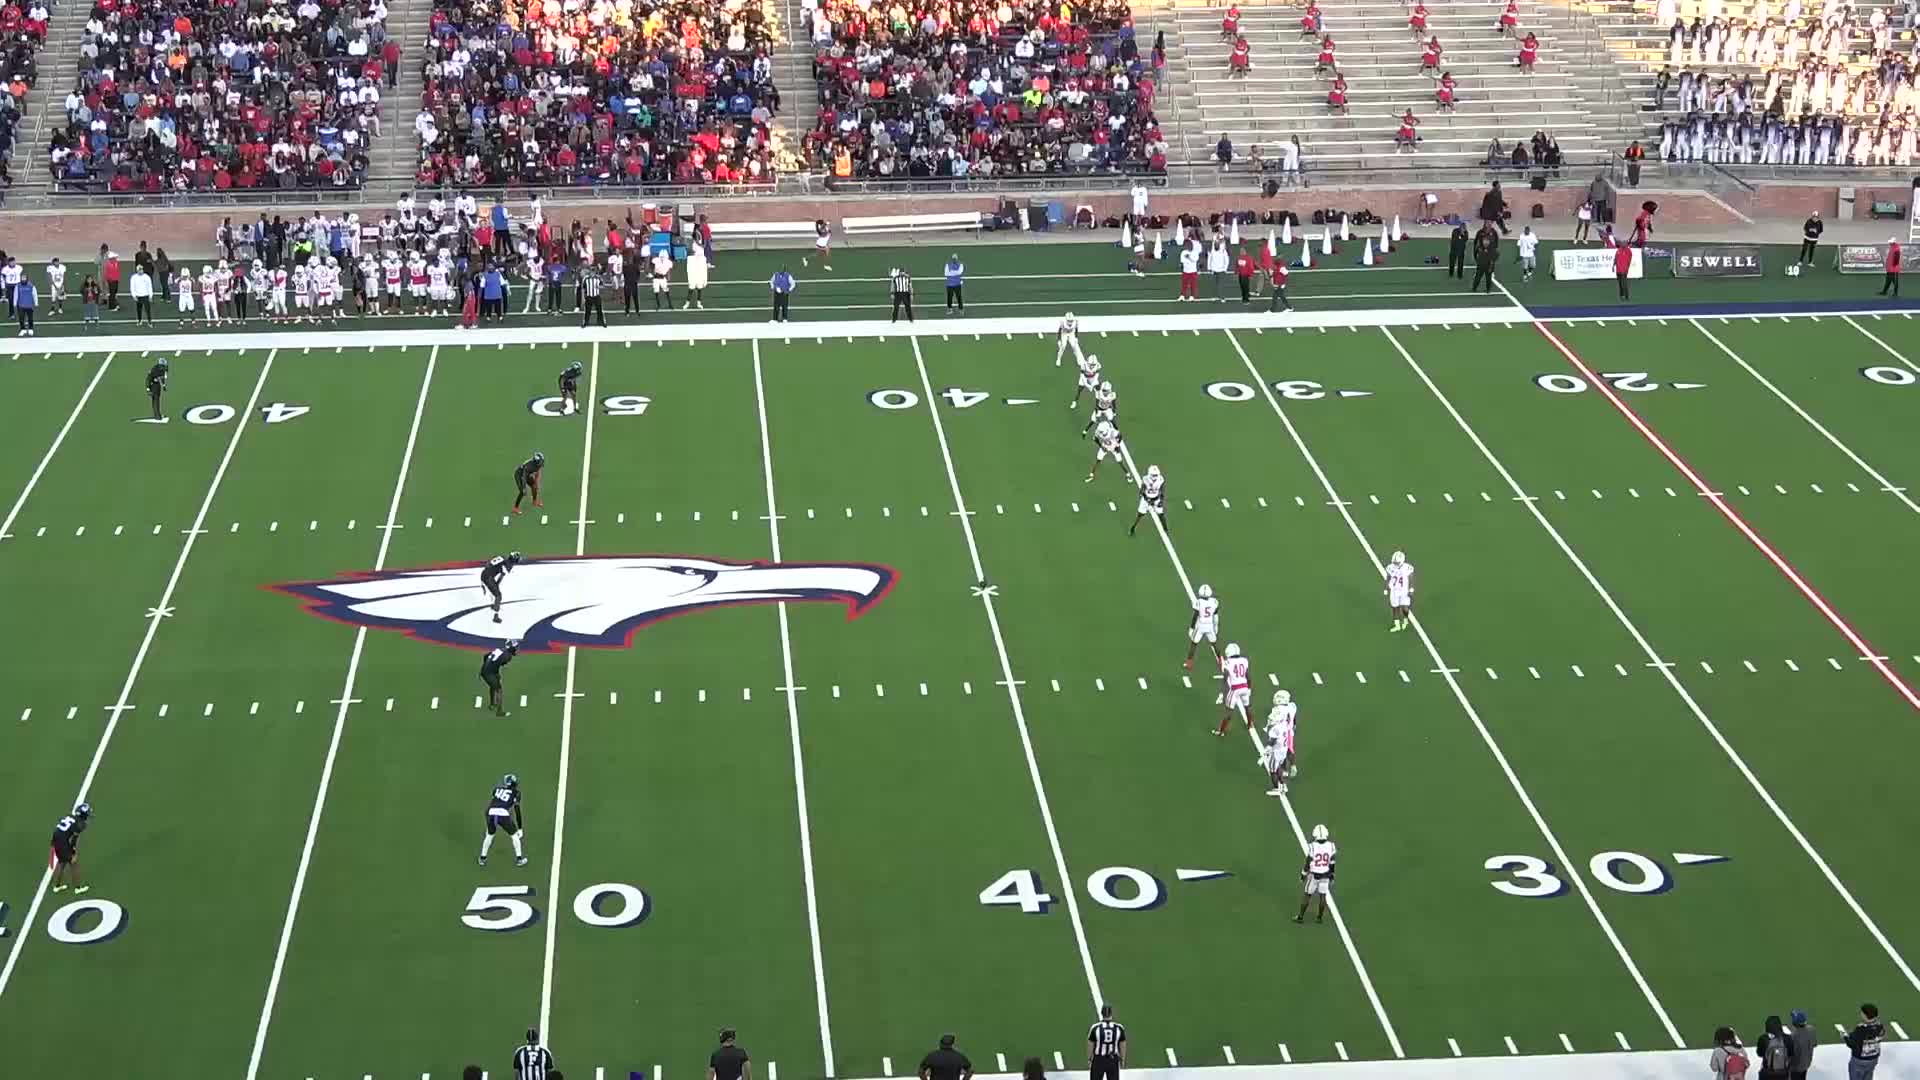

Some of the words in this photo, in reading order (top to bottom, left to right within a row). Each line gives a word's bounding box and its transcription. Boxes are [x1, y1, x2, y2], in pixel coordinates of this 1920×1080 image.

[1680, 255, 1757, 268] SEWELL
[1787, 265, 1800, 276] 10
[1203, 606, 1212, 618] 5
[1233, 663, 1246, 678] 40
[494, 788, 513, 802] 46
[1314, 853, 1330, 868] 29
[1103, 1029, 1114, 1043] B
[527, 1051, 539, 1066] F
